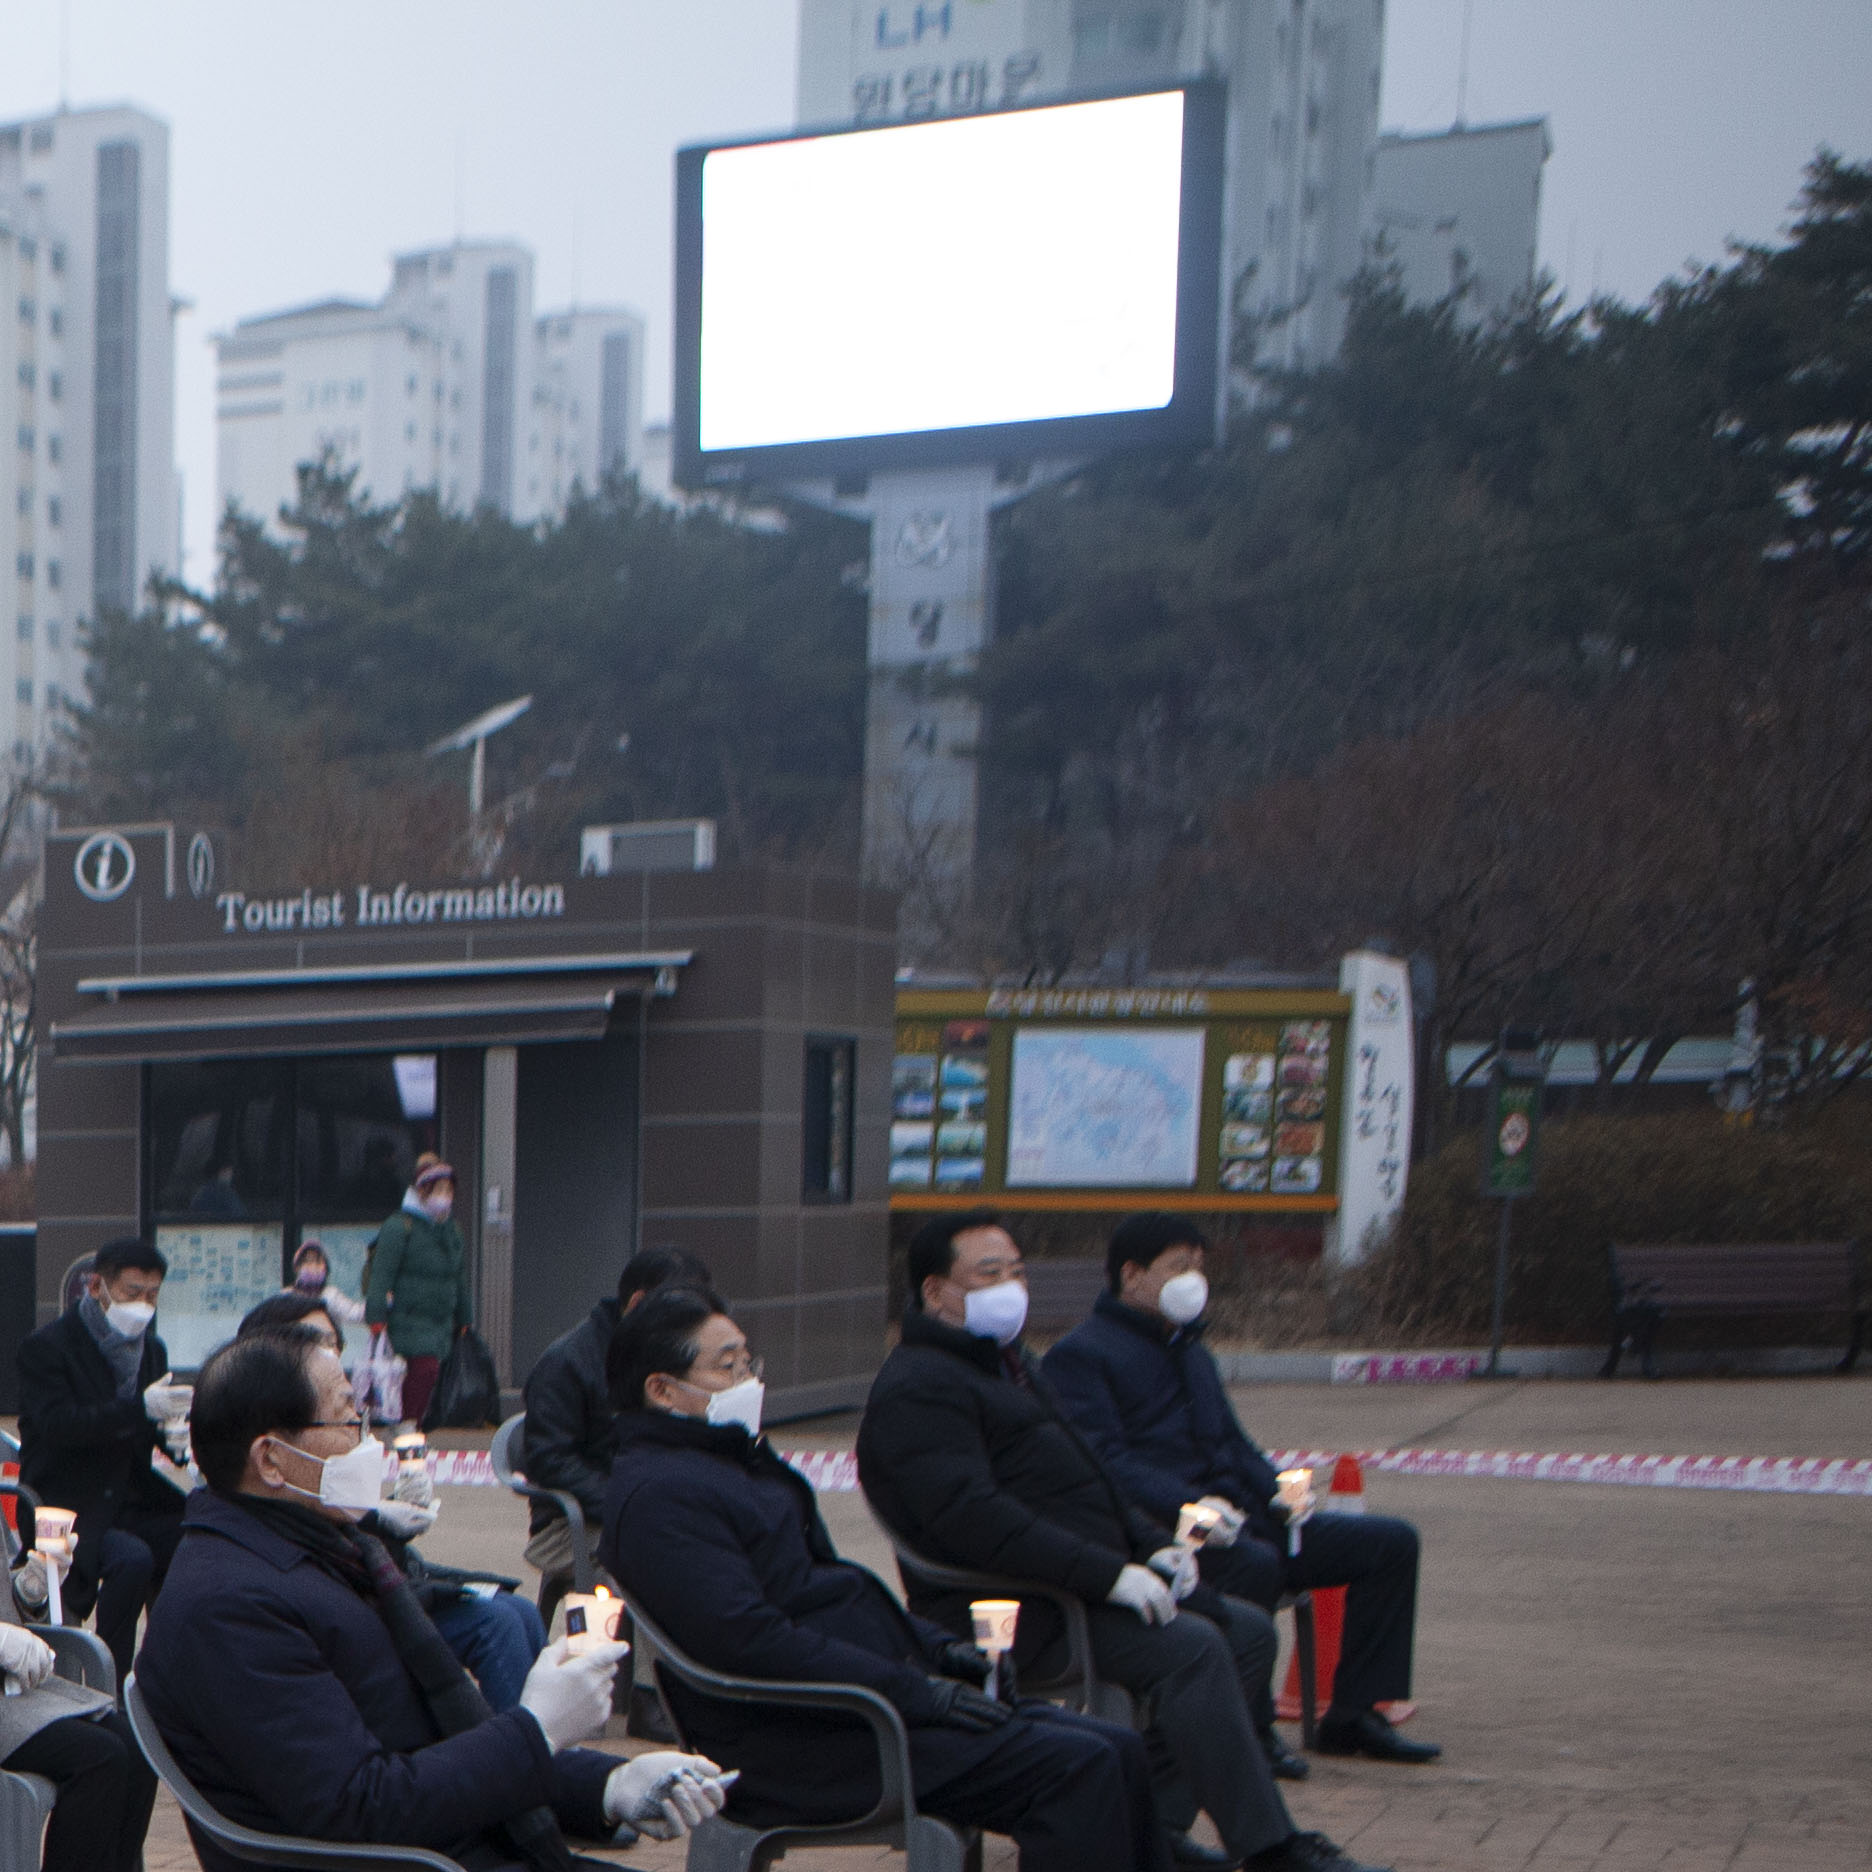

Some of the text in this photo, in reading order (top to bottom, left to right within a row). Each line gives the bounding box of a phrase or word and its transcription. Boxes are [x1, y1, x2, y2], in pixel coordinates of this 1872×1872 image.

[876, 0, 953, 49] LH
[217, 876, 566, 933] Tourist Information
